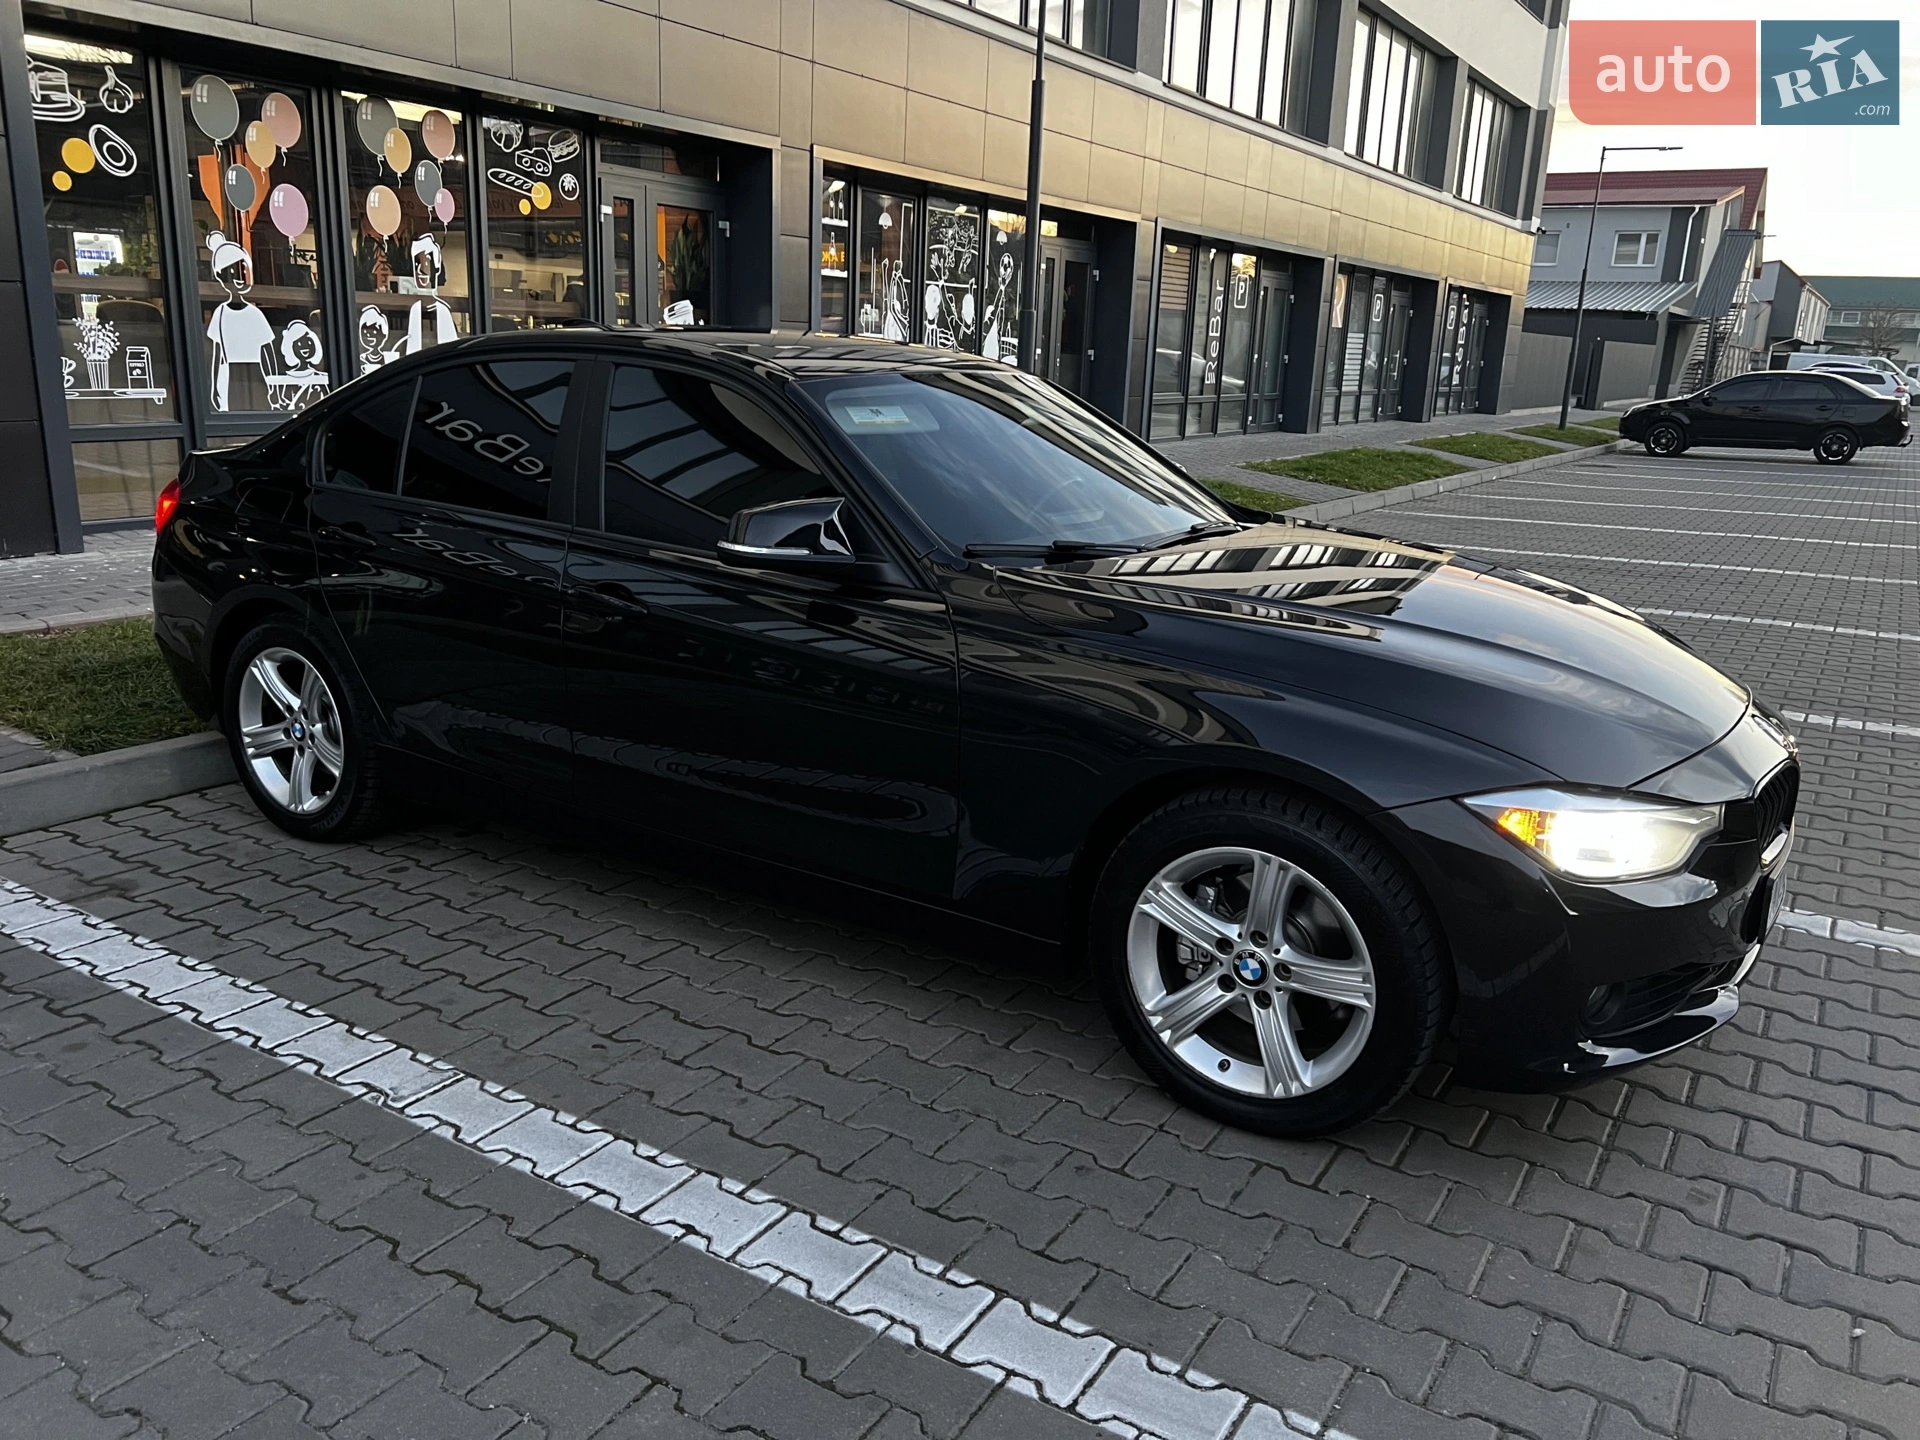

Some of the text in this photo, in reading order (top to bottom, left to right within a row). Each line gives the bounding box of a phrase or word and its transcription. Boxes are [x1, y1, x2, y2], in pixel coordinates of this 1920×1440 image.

[1238, 282, 1245, 300] P
[1204, 279, 1224, 384] ReBar
[1452, 294, 1469, 385] ReBar
[1234, 951, 1262, 966] BMW
